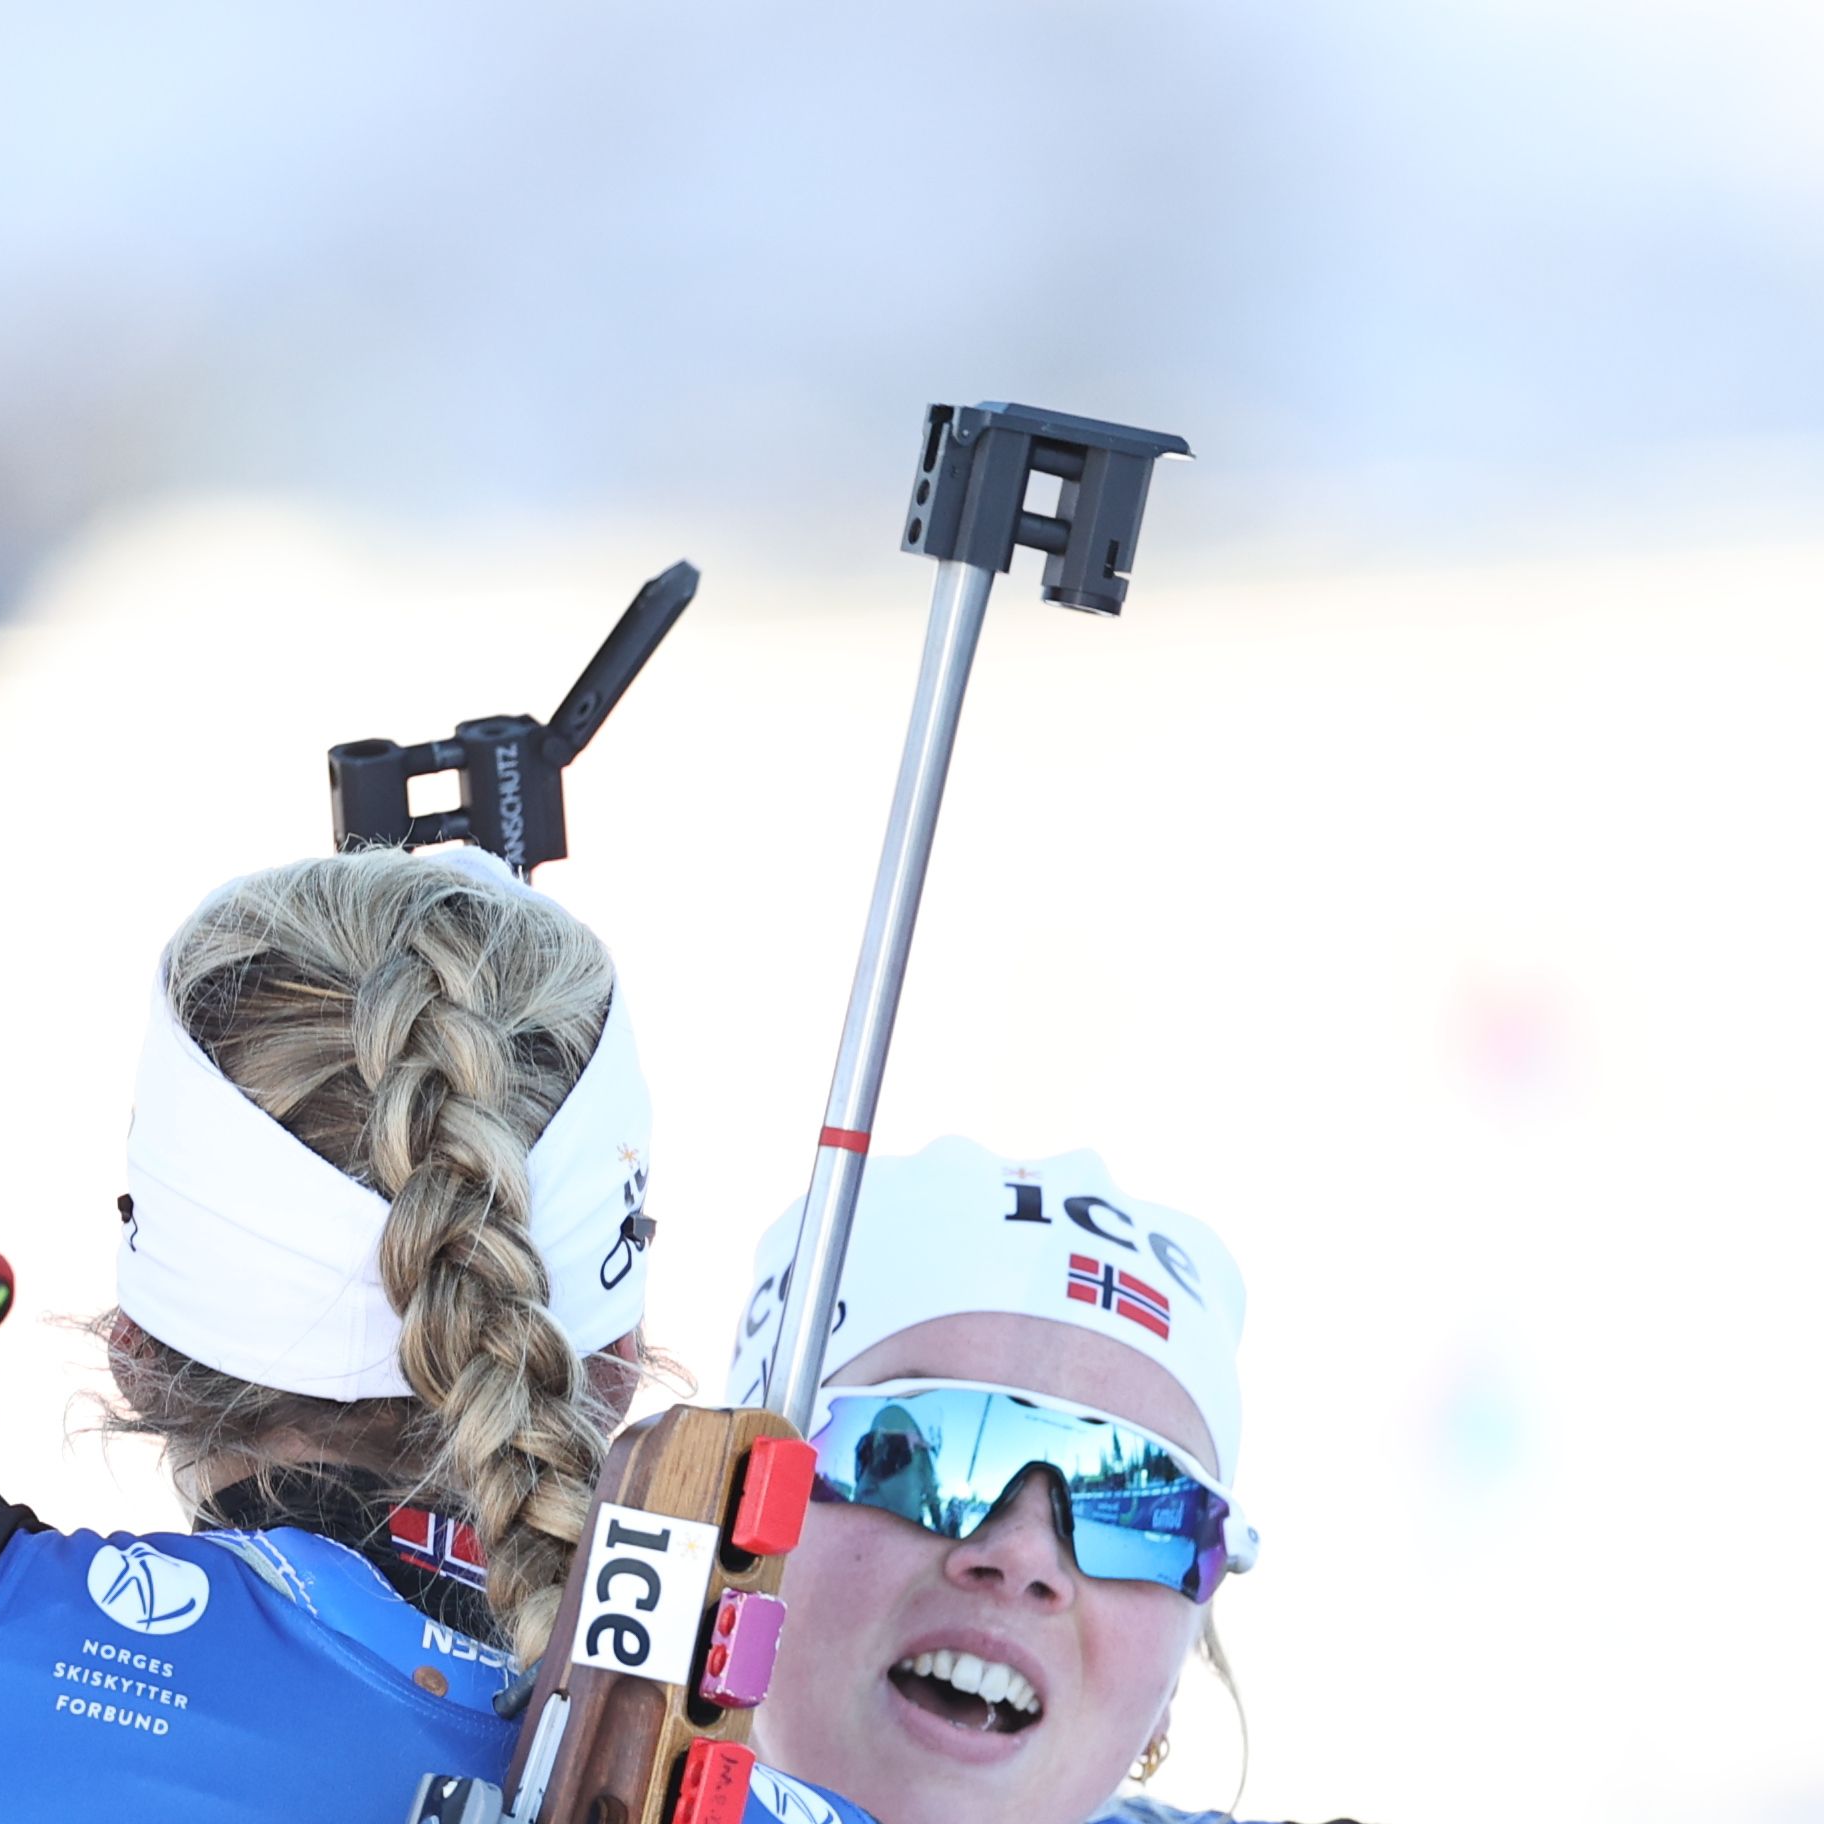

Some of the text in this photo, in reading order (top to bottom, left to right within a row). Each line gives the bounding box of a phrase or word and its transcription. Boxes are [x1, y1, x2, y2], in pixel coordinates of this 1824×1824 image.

[82, 1638, 174, 1678] NORGES
[52, 1661, 189, 1710] SKISKYTTER
[55, 1694, 169, 1736] FORBUND
